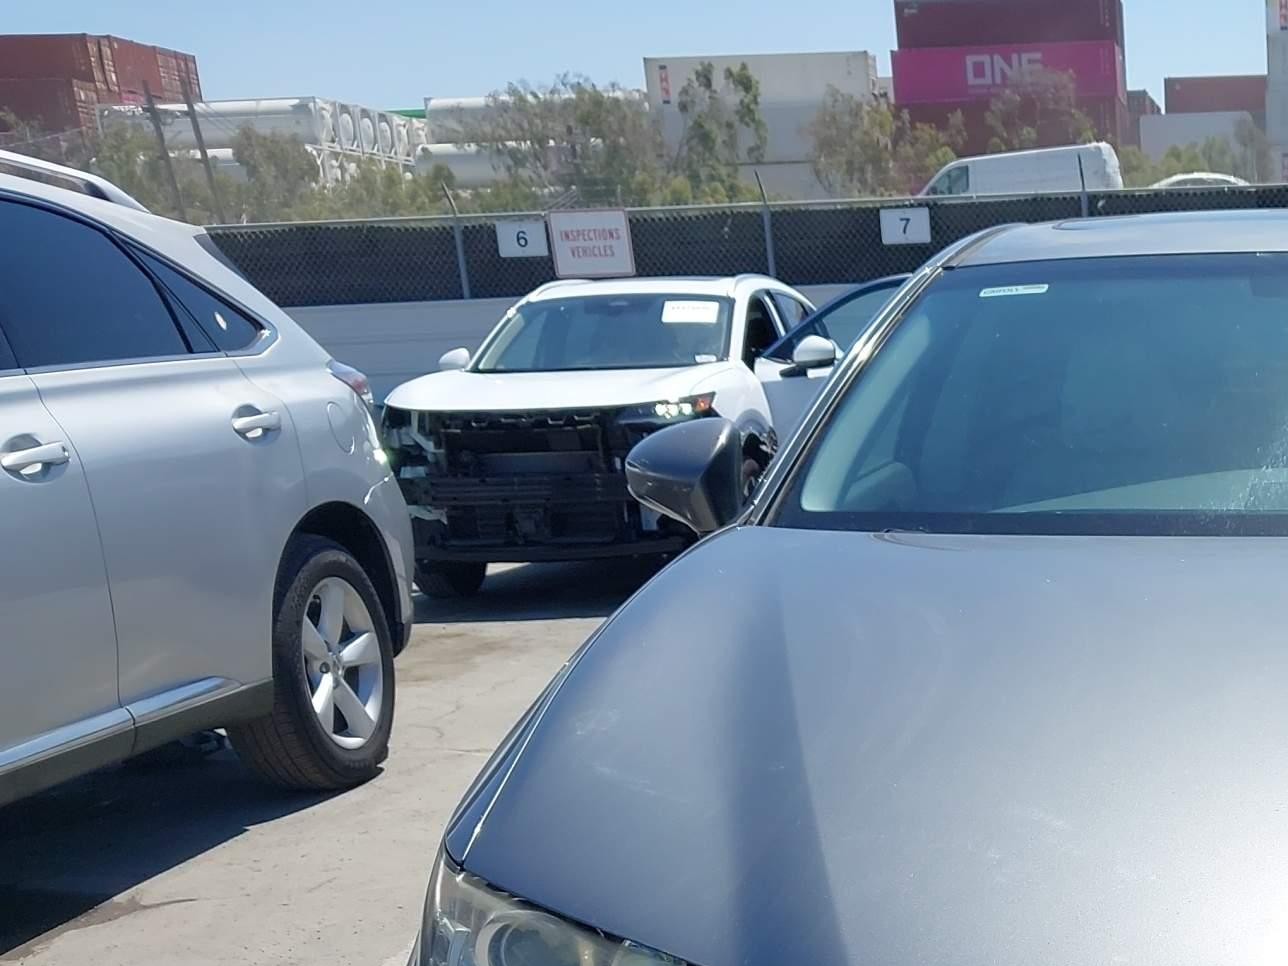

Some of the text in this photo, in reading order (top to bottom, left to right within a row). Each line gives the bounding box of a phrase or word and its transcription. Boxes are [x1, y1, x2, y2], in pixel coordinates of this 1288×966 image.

[966, 53, 1042, 85] ONE
[560, 228, 621, 242] INSPECTIONS
[899, 217, 911, 235] 7
[515, 230, 529, 248] 6
[570, 245, 615, 258] VEHICLES
